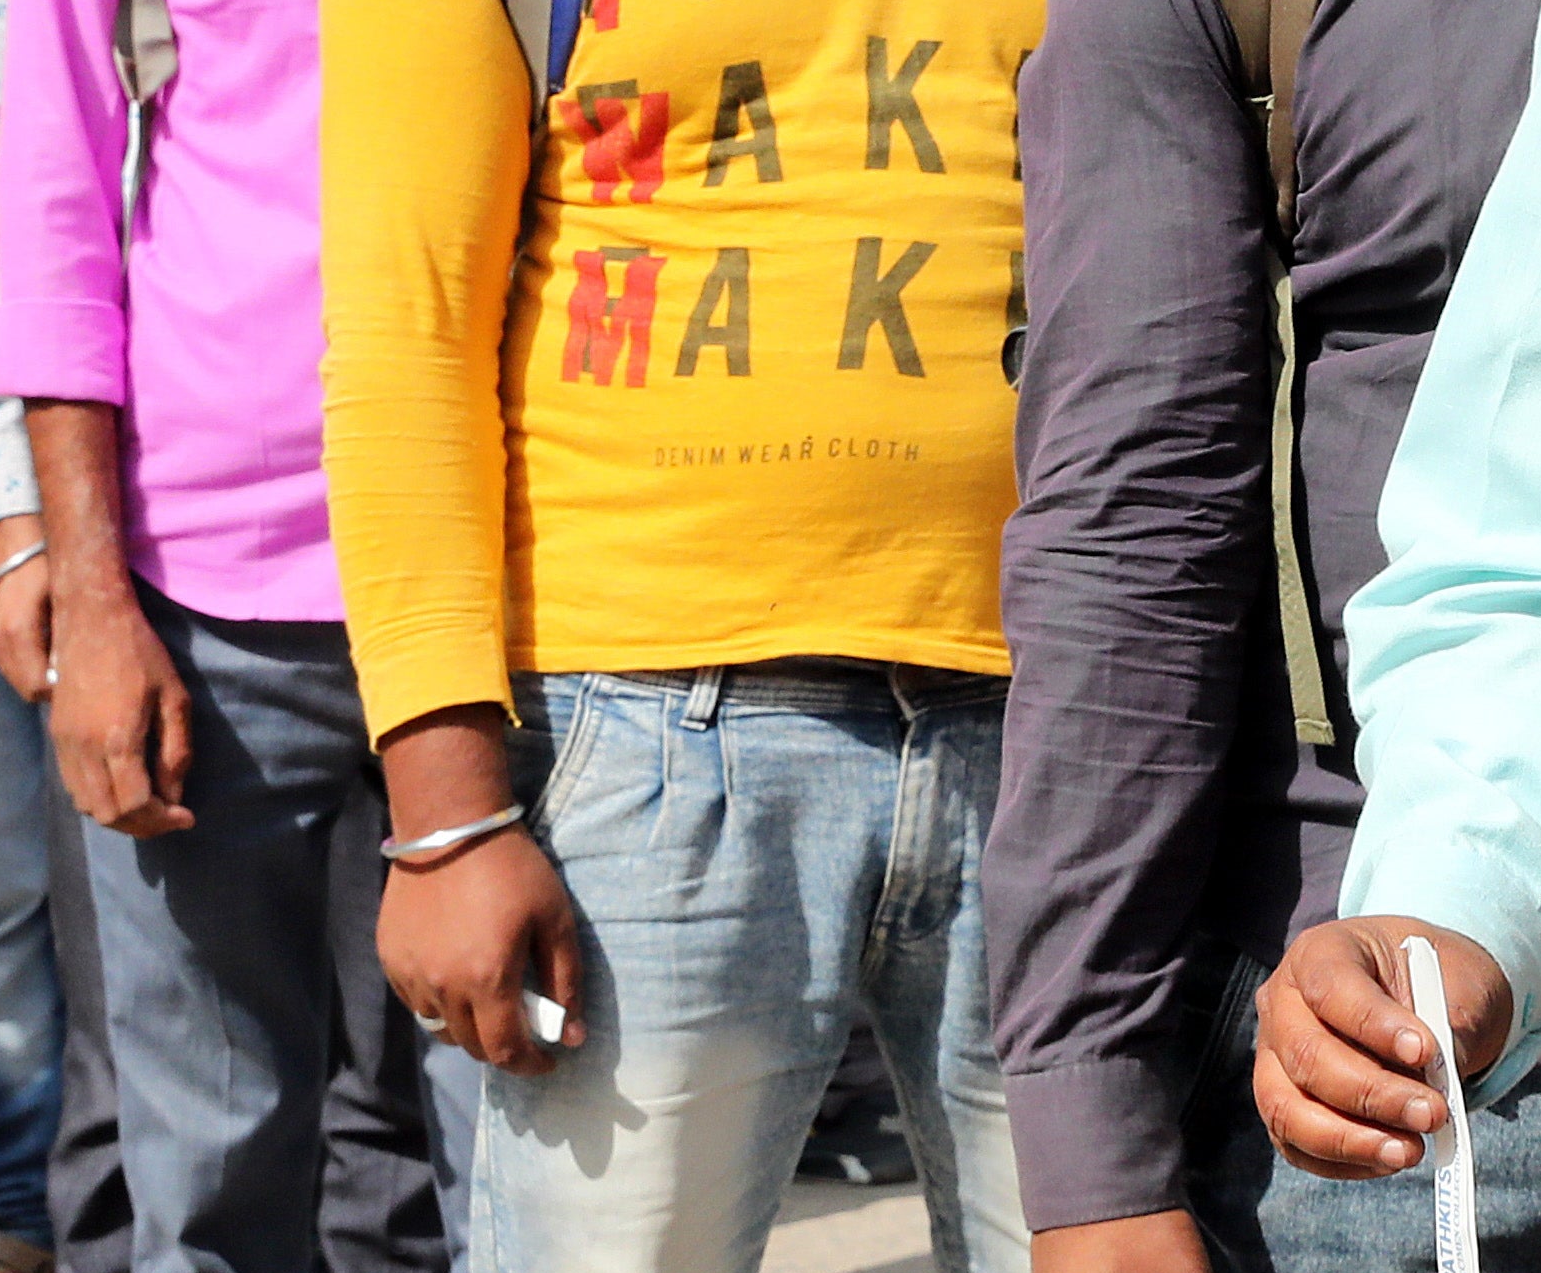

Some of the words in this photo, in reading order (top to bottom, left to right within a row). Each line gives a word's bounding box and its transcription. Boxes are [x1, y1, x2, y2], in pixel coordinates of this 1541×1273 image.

[655, 446, 725, 467] DENIM
[739, 438, 814, 464] WEAR
[828, 438, 920, 462] CLOTH
